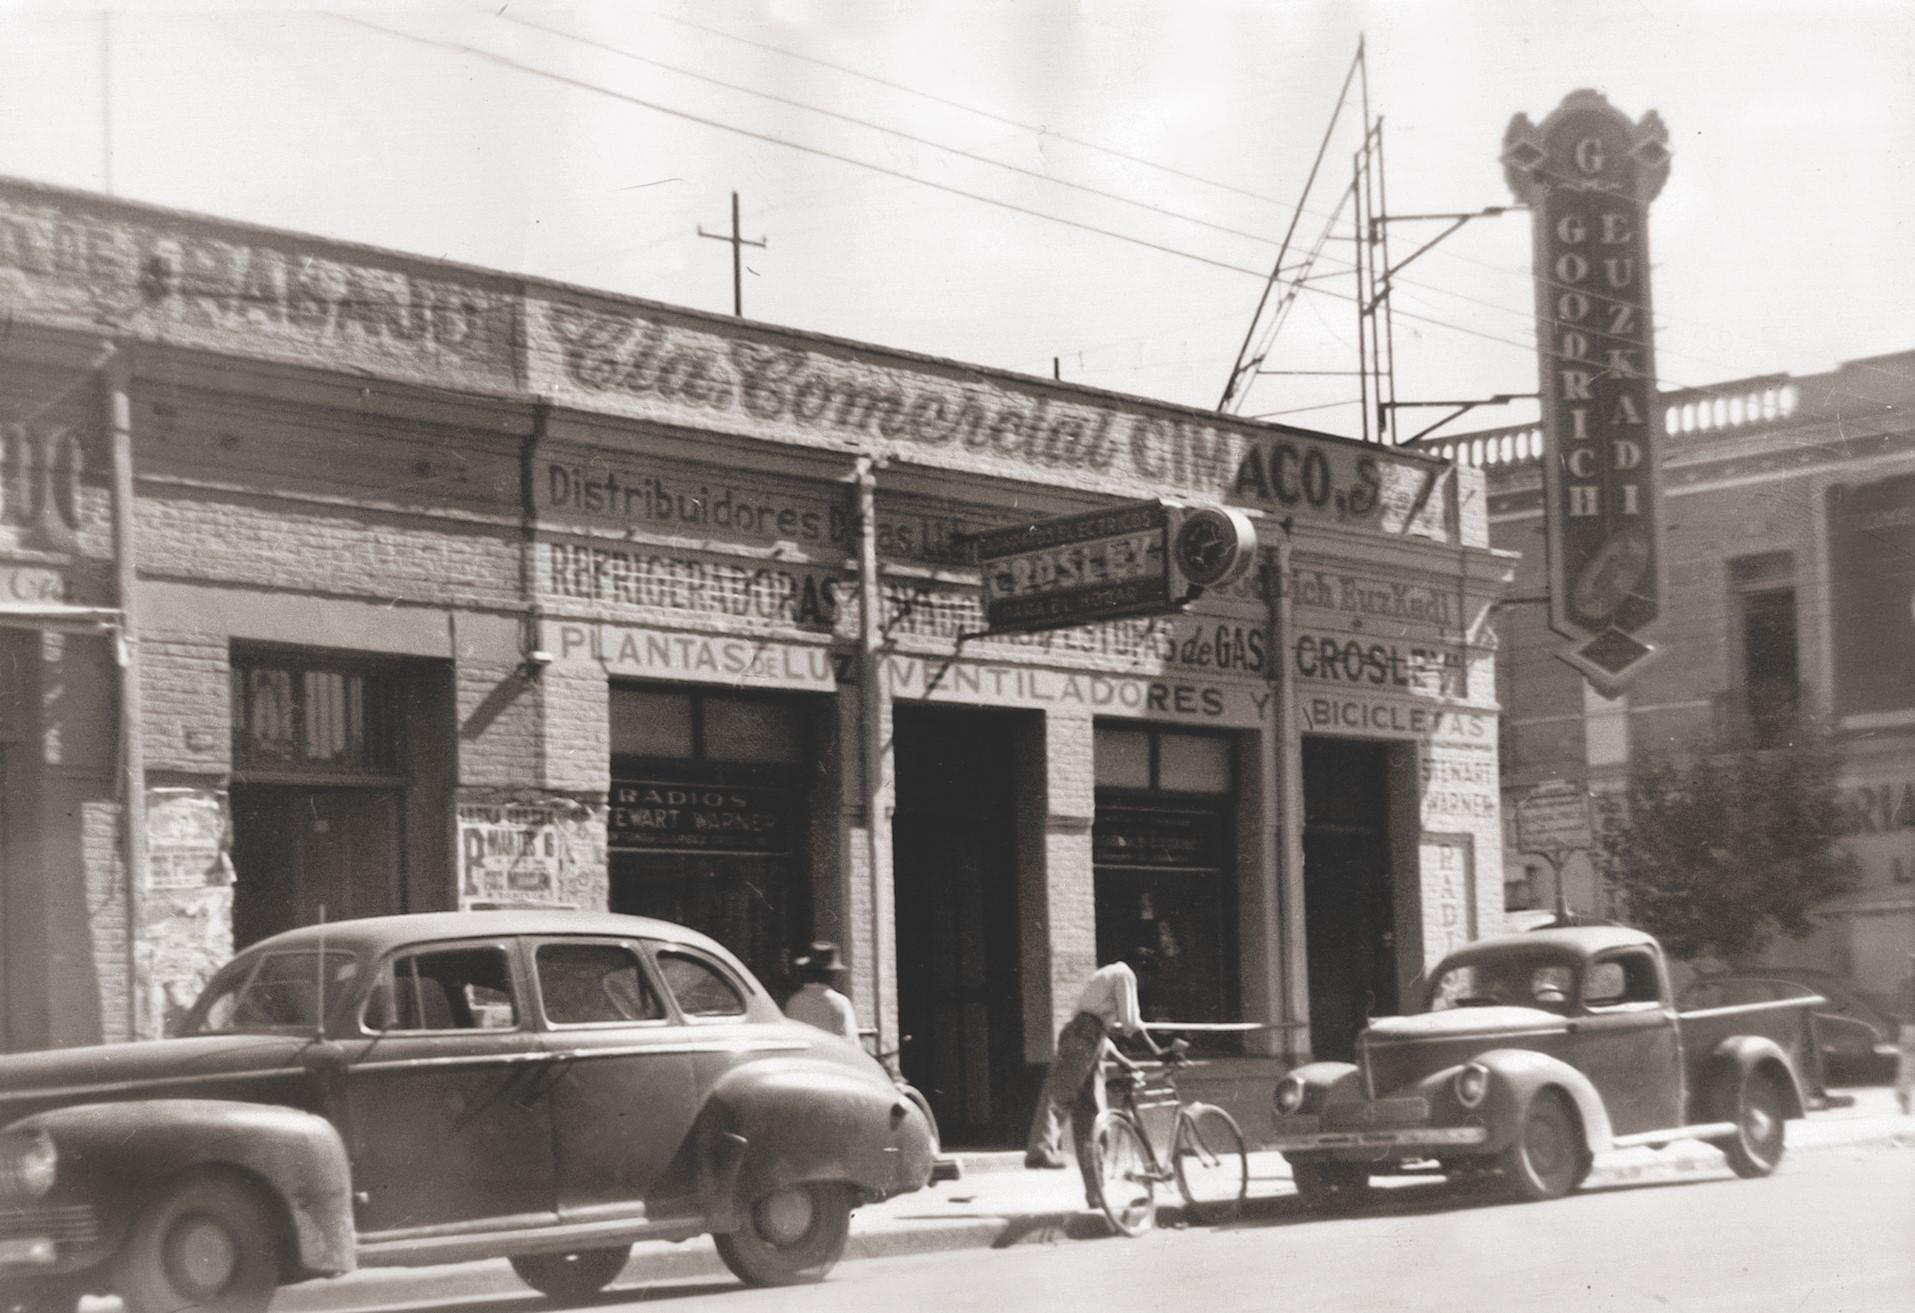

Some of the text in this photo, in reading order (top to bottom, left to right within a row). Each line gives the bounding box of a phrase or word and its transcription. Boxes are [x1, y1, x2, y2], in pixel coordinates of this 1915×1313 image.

[1555, 214, 1600, 517] GOODRICH
[1602, 213, 1643, 516] EUZKADI
[549, 463, 820, 540] Distribuidores
[989, 535, 1152, 598] CROSLEY
[560, 626, 746, 676] PLANTAS
[785, 648, 854, 684] LUZ
[886, 658, 1225, 717] VENTILADORES
[1249, 690, 1272, 723] Y
[1312, 699, 1484, 738] BICICLETAS
[1181, 624, 1213, 666] de
[1215, 624, 1265, 672] GAS
[614, 807, 681, 830] EWART
[618, 787, 748, 809] RADIOS
